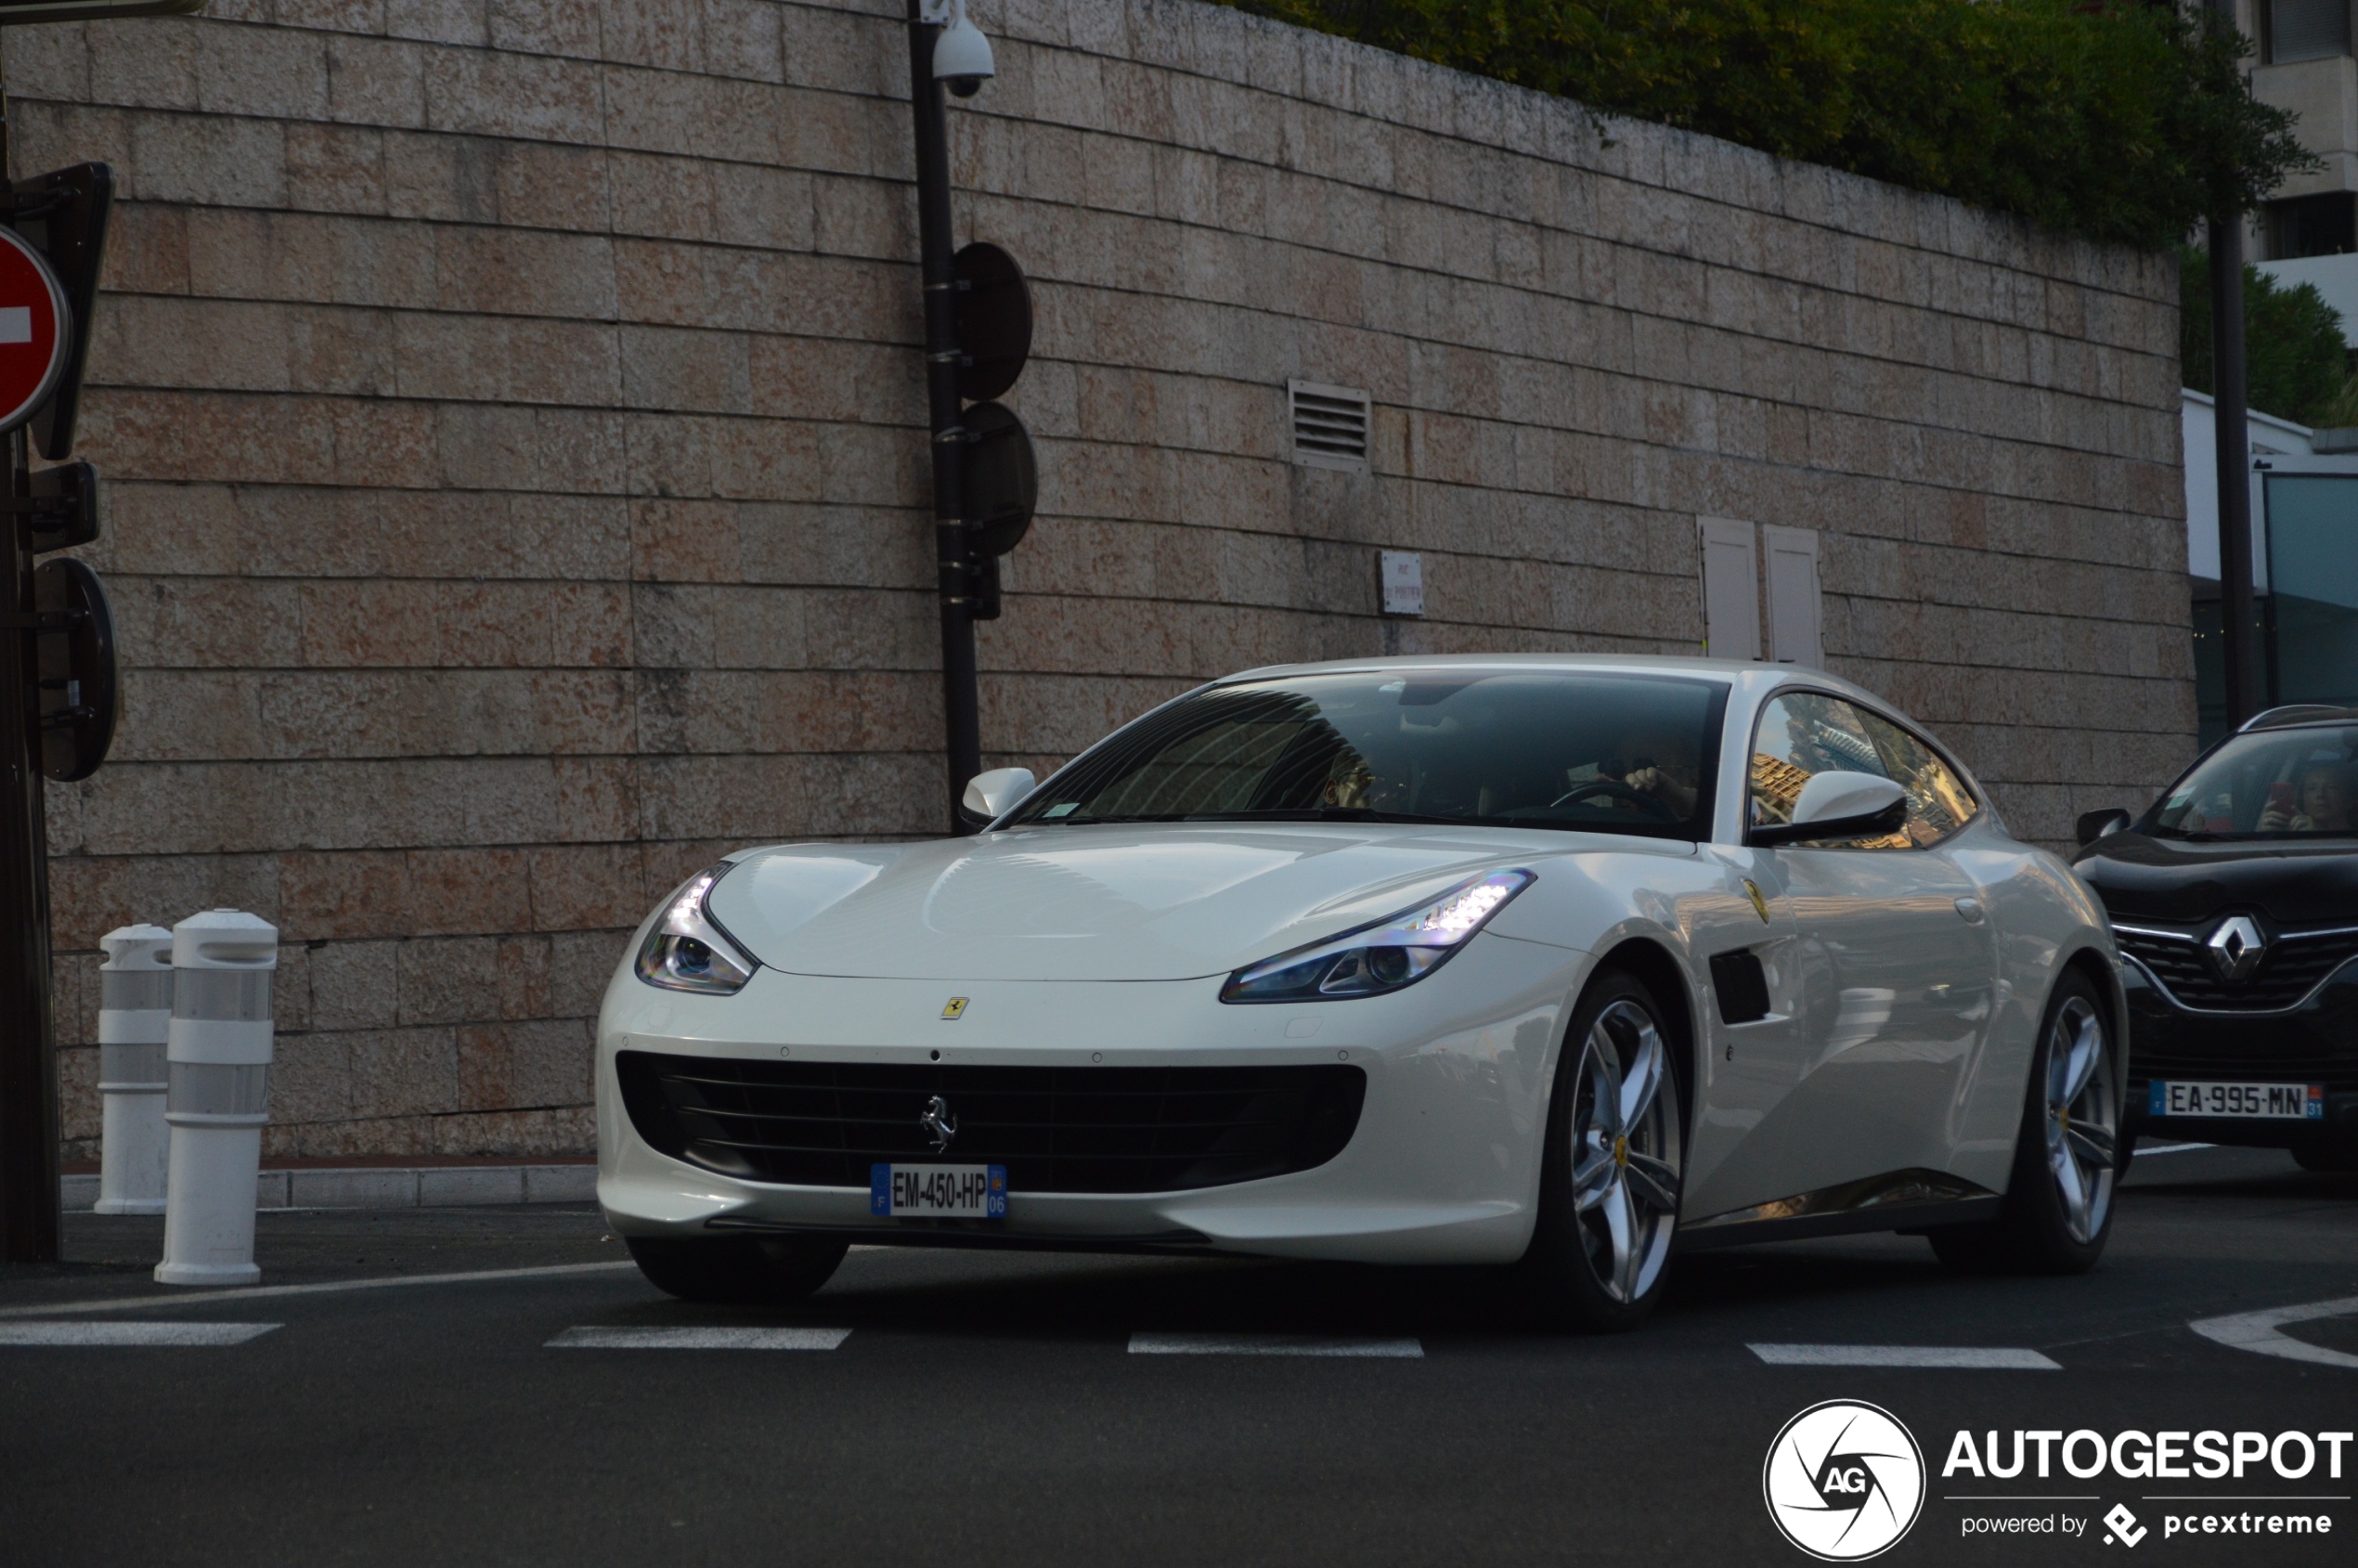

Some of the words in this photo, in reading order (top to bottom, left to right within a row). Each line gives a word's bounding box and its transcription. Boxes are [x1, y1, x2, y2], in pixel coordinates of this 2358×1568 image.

[2170, 1085, 2301, 1115] EA-995-MN
[2308, 1103, 2322, 1116] 31
[893, 1172, 986, 1209] EM-450-HP
[877, 1196, 886, 1209] F
[989, 1196, 1004, 1213] 06
